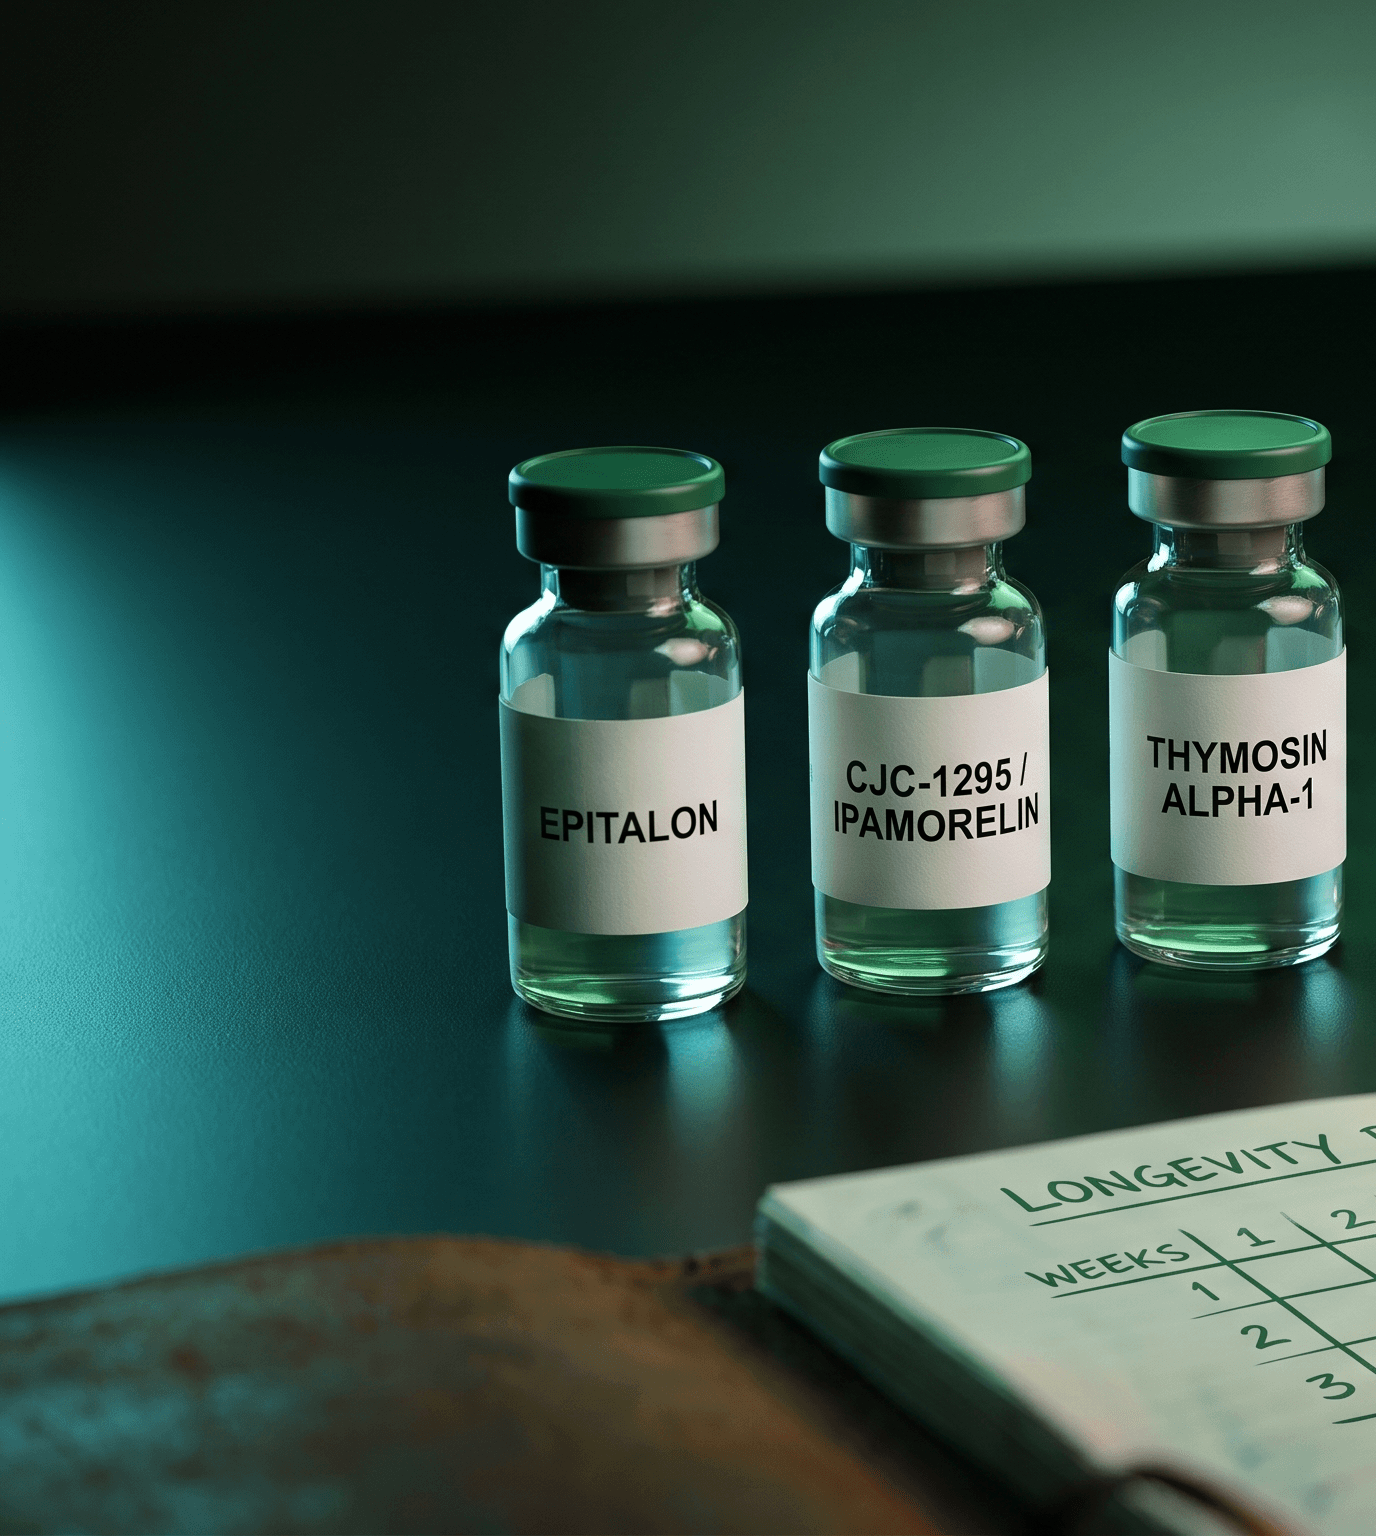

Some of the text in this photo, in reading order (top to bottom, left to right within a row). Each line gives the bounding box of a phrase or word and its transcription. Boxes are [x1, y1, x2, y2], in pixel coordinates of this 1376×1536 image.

[844, 750, 1030, 799] CJC-1295 /
[1145, 728, 1328, 775] THYMOSIN
[833, 791, 1040, 844] IPAMORELIN
[1159, 776, 1314, 819] ALPHA-1
[538, 798, 719, 846] EPITALON
[998, 1132, 1343, 1215] LONGEVITY
[1023, 1242, 1191, 1289] WEEKS
[1235, 1226, 1277, 1249] 1
[1190, 1280, 1222, 1303] 1
[1239, 1323, 1293, 1351] 2
[1304, 1371, 1357, 1402] 3
